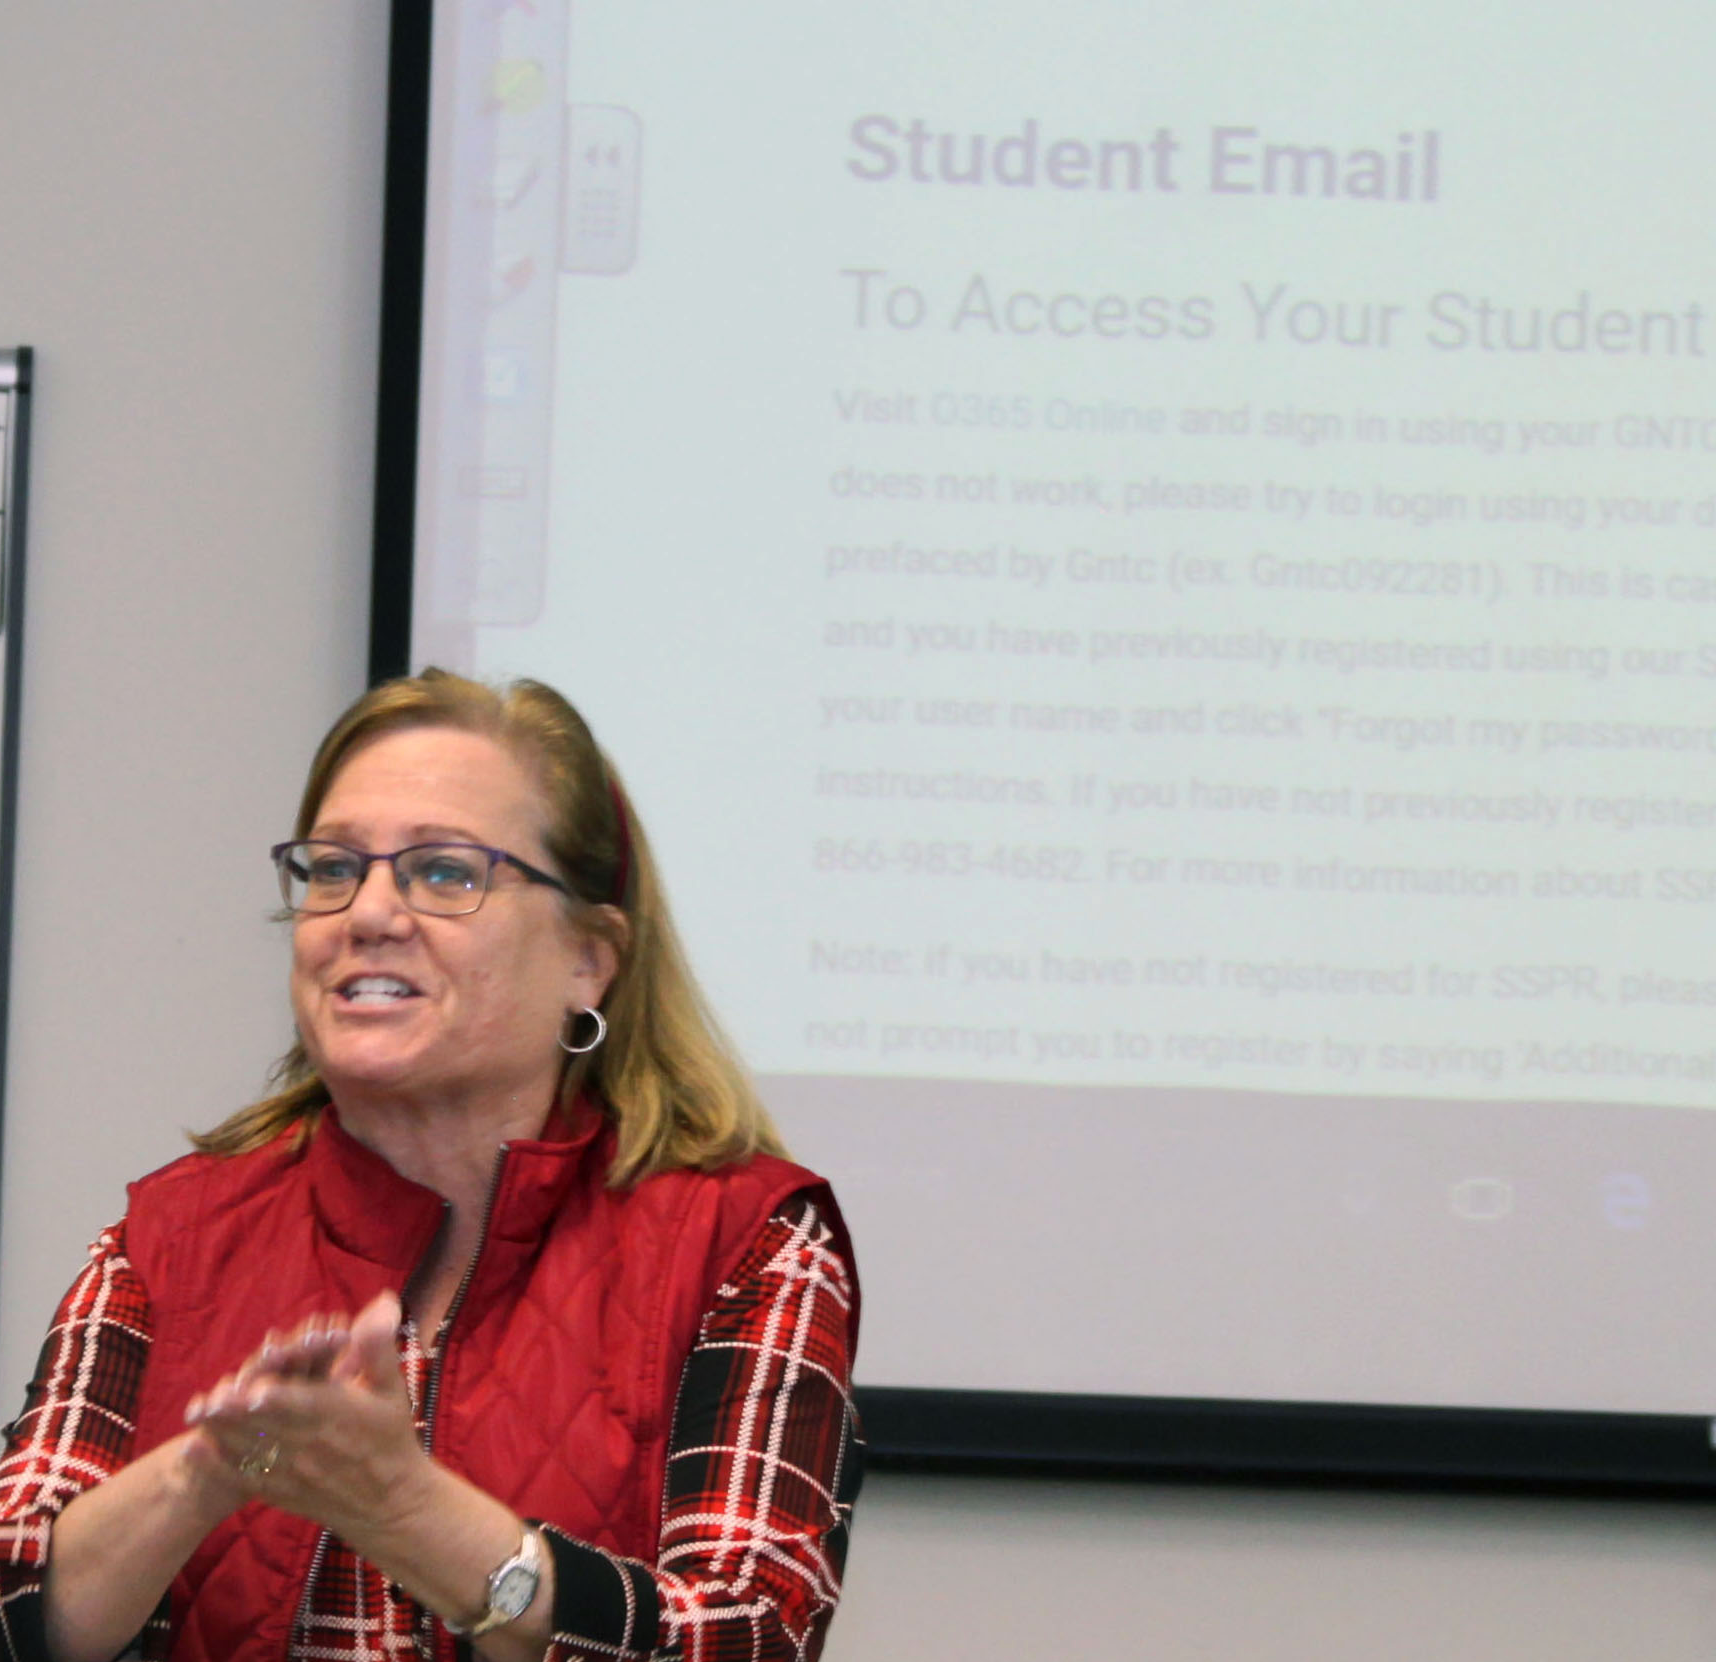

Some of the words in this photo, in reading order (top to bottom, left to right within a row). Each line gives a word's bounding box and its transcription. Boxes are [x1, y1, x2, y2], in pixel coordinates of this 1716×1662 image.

[847, 111, 1179, 192] Student
[1207, 125, 1442, 202] Email
[843, 267, 927, 330] To
[950, 271, 1215, 340] Access
[1242, 282, 1400, 347] Your
[1426, 288, 1705, 357] Student
[832, 389, 918, 425] Visit
[1178, 402, 1252, 437] and
[1261, 404, 1345, 449] sign
[1351, 406, 1390, 441] in
[1397, 410, 1507, 455] using
[1517, 419, 1600, 456] your
[828, 463, 925, 500] does
[934, 472, 1000, 503] not
[1121, 475, 1253, 518] please
[1261, 482, 1315, 524] try
[1323, 484, 1363, 516] to
[1371, 482, 1469, 528] login
[1478, 488, 1590, 533] using
[1593, 497, 1682, 534] your
[823, 540, 1000, 582] prefaced
[1006, 544, 1056, 590] by
[1064, 546, 1157, 583] Gntc
[1530, 563, 1610, 599] This
[1619, 566, 1654, 600] is
[823, 614, 896, 649] and
[905, 623, 978, 660] you
[984, 618, 1081, 655] have
[1087, 625, 1290, 673] previously
[1295, 632, 1493, 675] registered
[1500, 638, 1611, 684] using
[1620, 648, 1686, 676] our
[820, 695, 901, 732] your
[915, 698, 996, 727] user
[1009, 701, 1120, 731] name
[1131, 700, 1206, 734] and
[1215, 702, 1303, 738] click
[1468, 717, 1529, 756] my
[1107, 780, 1179, 817] you
[1187, 776, 1280, 812] have
[1289, 784, 1353, 815] not
[1362, 785, 1562, 832] previously
[1104, 848, 1170, 883] For
[1180, 858, 1283, 887] more
[1292, 854, 1520, 896] information
[1530, 863, 1643, 900] about
[961, 952, 1030, 989] you
[1039, 947, 1134, 984] have
[1141, 956, 1207, 987] not
[1219, 956, 1416, 1000] registered
[1425, 961, 1477, 997] for
